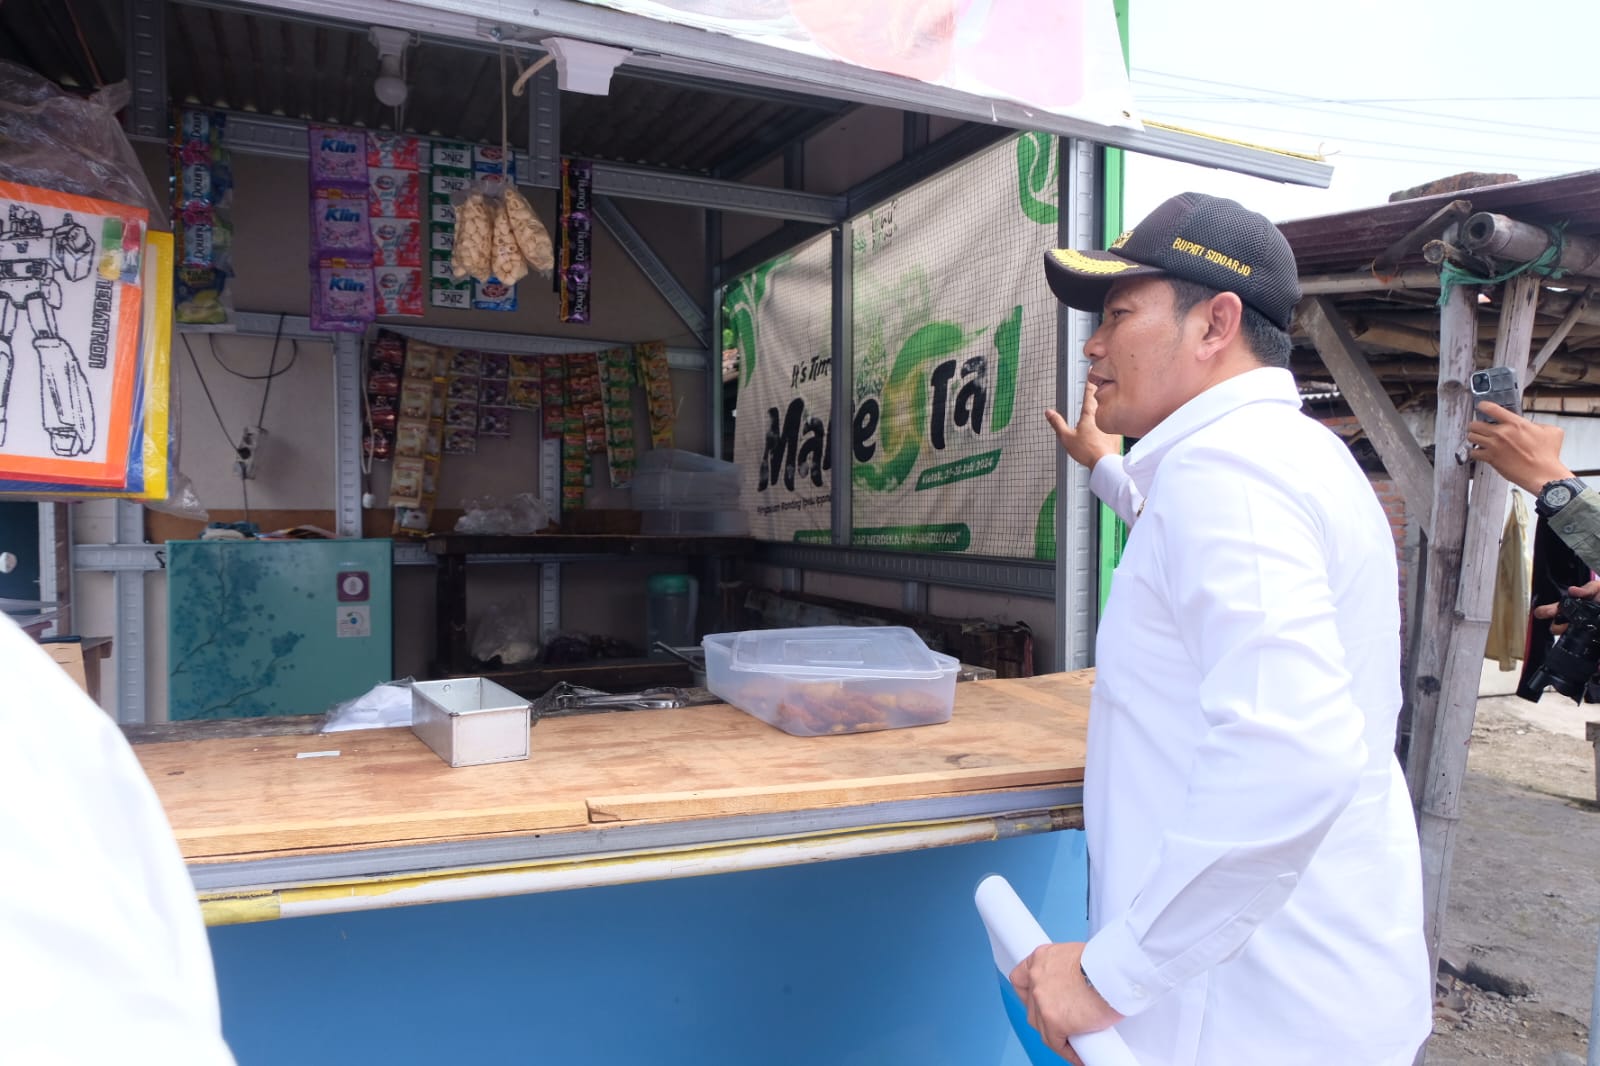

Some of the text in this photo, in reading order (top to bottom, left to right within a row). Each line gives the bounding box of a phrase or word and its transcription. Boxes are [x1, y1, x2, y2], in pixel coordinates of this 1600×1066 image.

[321, 137, 357, 153] Klin
[441, 151, 464, 164] ZINC
[192, 163, 206, 198] Downy
[440, 179, 464, 191] ZINC
[577, 175, 589, 209] Downy
[325, 207, 360, 222] Klin
[440, 207, 455, 219] NC
[194, 223, 209, 258] Downy
[440, 235, 454, 247] NC
[576, 230, 589, 261] Downy
[1173, 237, 1252, 277] BUPATI SIDOARJO
[329, 277, 365, 292] Klin
[440, 293, 463, 304] ZINC
[575, 280, 588, 313] Downy
[791, 355, 832, 389] It's Tim
